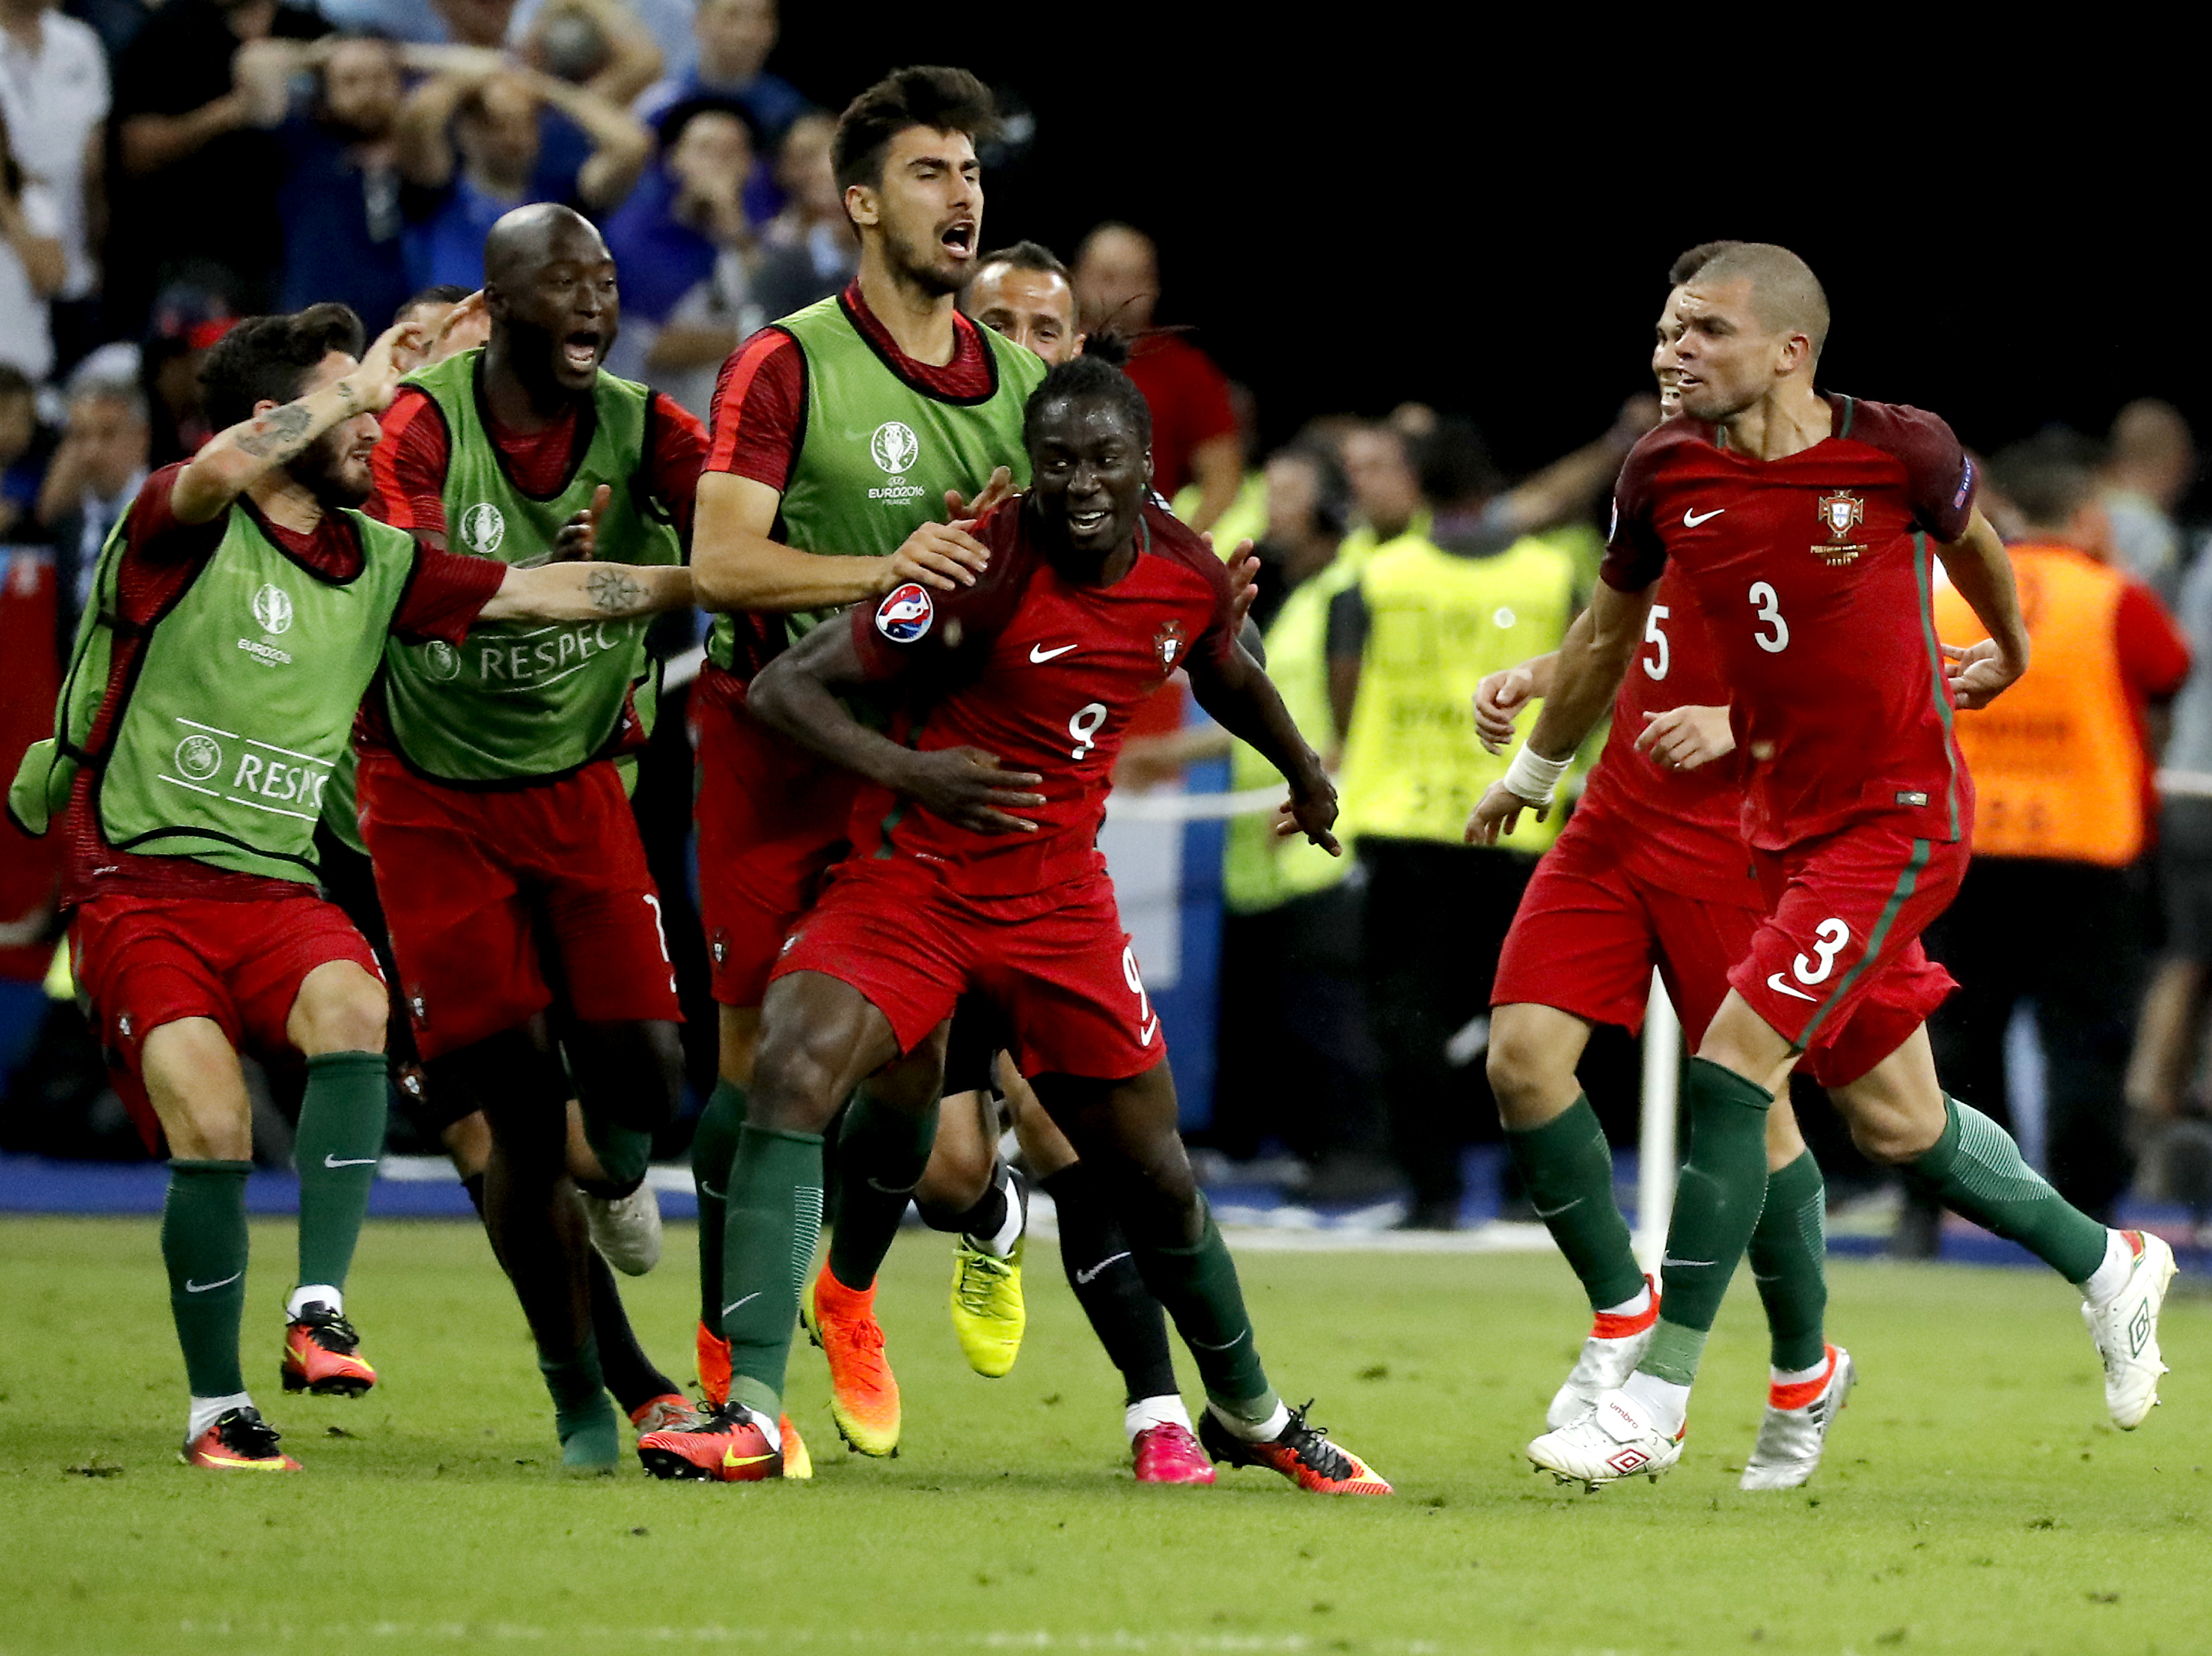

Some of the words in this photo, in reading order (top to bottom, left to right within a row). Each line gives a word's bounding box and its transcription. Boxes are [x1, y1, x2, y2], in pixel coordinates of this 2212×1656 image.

[868, 485, 925, 499] EURO2016
[1643, 604, 1669, 681] 5
[1749, 581, 1789, 653] 3
[1069, 702, 1107, 760] 9
[1122, 946, 1149, 1021] 9
[1793, 917, 1850, 985] 3
[1610, 1402, 1638, 1429] umbro
